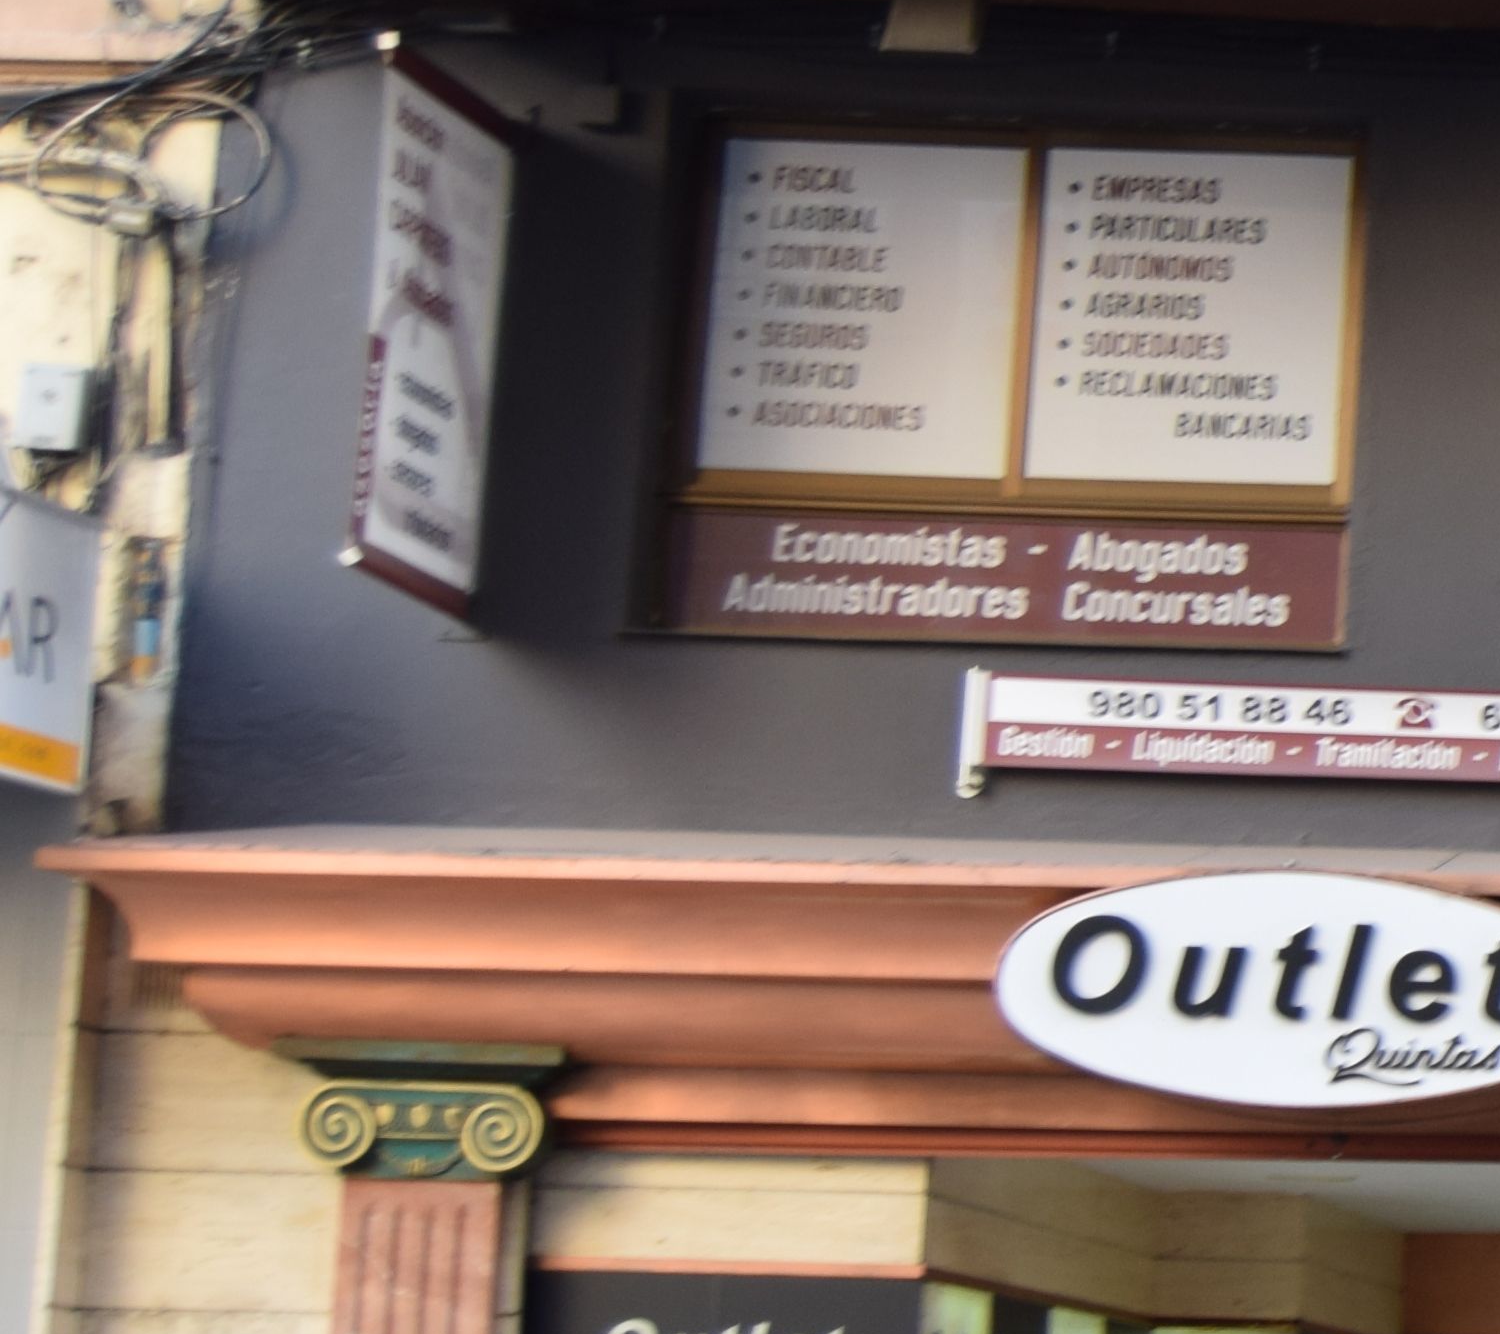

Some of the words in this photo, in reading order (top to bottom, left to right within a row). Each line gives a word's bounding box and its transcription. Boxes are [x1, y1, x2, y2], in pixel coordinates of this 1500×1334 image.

[773, 167, 855, 194] FISCAL
[1092, 175, 1222, 204] EMPRESAS
[769, 205, 877, 233] LABORAL
[1089, 214, 1268, 245] PARTICULARES
[767, 244, 889, 273] CONTABLE
[762, 282, 904, 312] FINANCIERO
[1084, 292, 1205, 321] AGRARIOS
[758, 324, 869, 353] SEGUROS
[1082, 333, 1230, 362] SOCIEDADES
[1079, 369, 1277, 402] RECLAMACIONES
[751, 402, 925, 432] ASOCIACIONES
[1174, 413, 1311, 443] BANCARIAS
[772, 523, 1008, 570] Economistas
[1066, 531, 1249, 584] Abogados
[722, 573, 1030, 620] Administradores
[1061, 583, 1292, 628] Concursales
[1088, 688, 1160, 720] 980
[1176, 693, 1223, 722] 51
[1241, 695, 1288, 725] 88
[1304, 698, 1354, 727] 46
[997, 724, 1096, 760] Gestión
[1131, 730, 1276, 768] Liquidación
